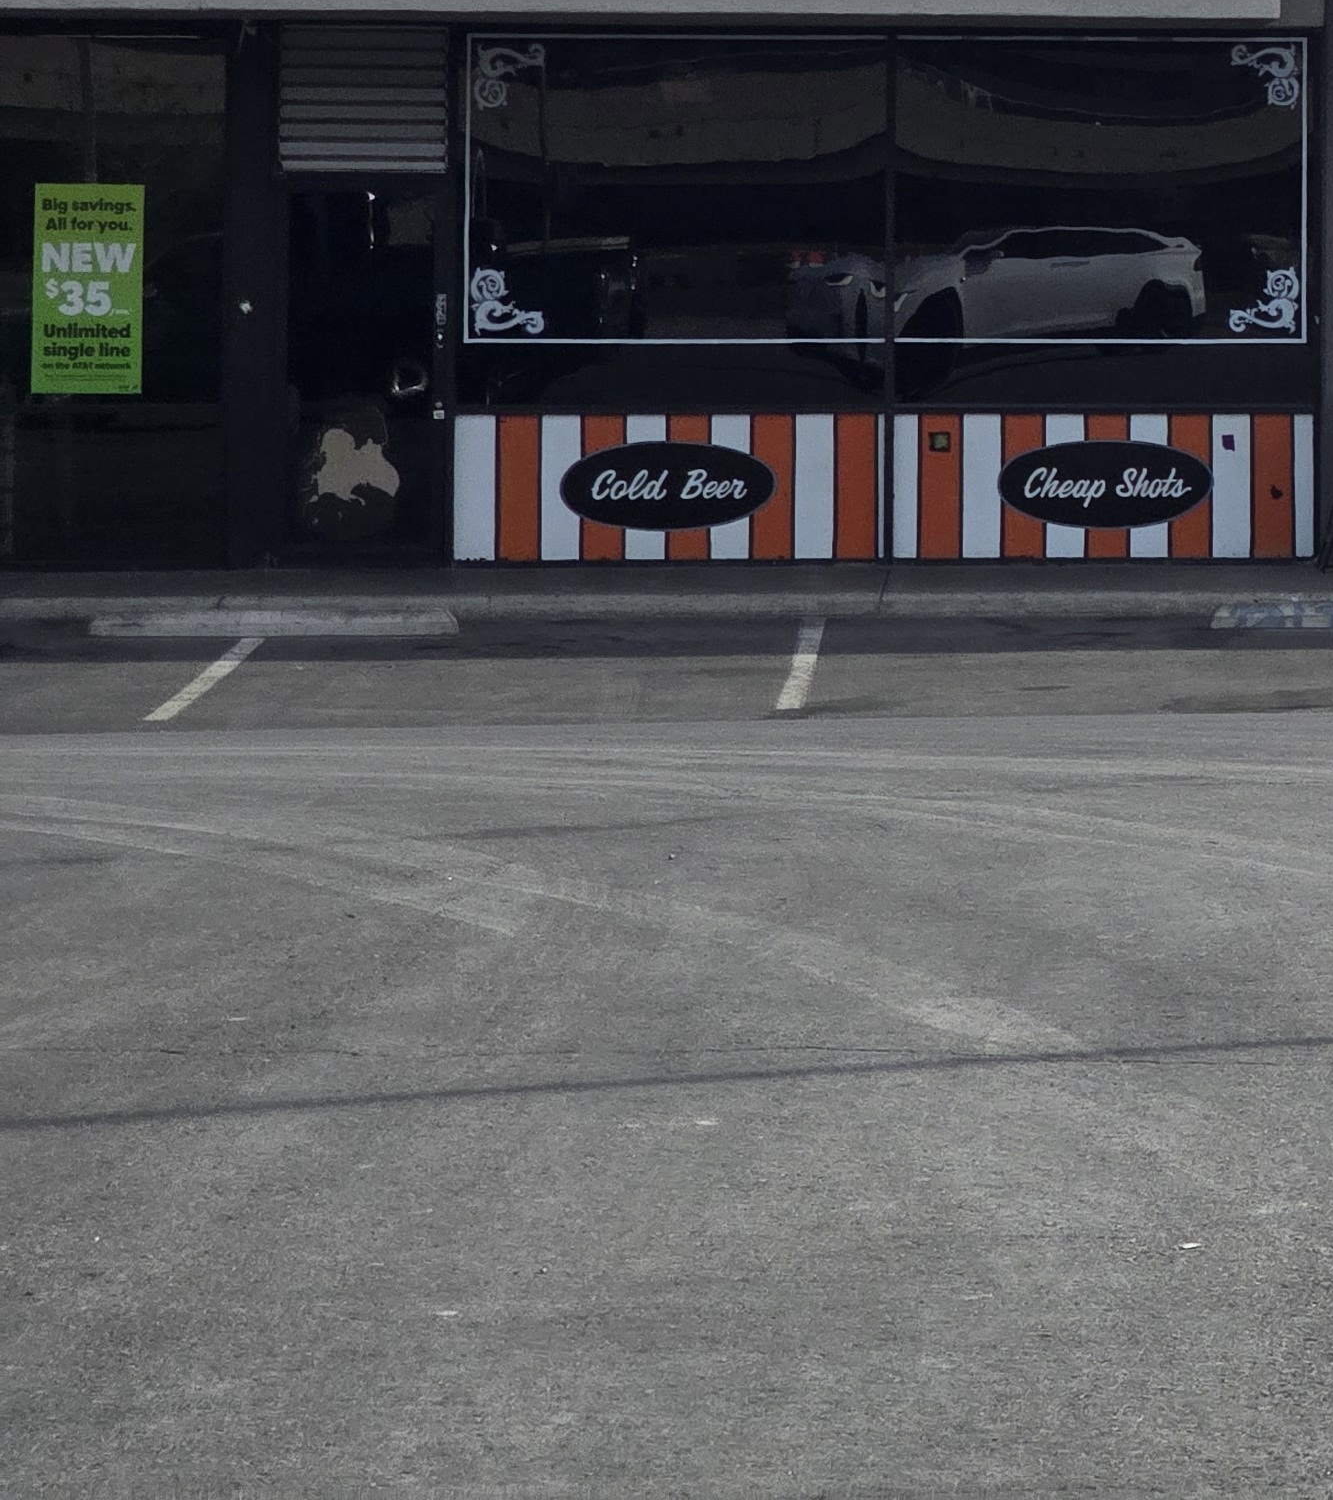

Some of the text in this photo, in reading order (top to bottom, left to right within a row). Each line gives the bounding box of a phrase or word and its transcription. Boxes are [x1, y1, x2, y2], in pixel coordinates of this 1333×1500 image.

[42, 198, 137, 214] Big savings.
[45, 217, 133, 234] All for you.
[42, 242, 137, 273] NEW
[43, 322, 131, 338] Unlimited
[43, 342, 131, 361] single line
[591, 469, 747, 500] Cold Beer
[1024, 467, 1192, 508] Cheap Shots
